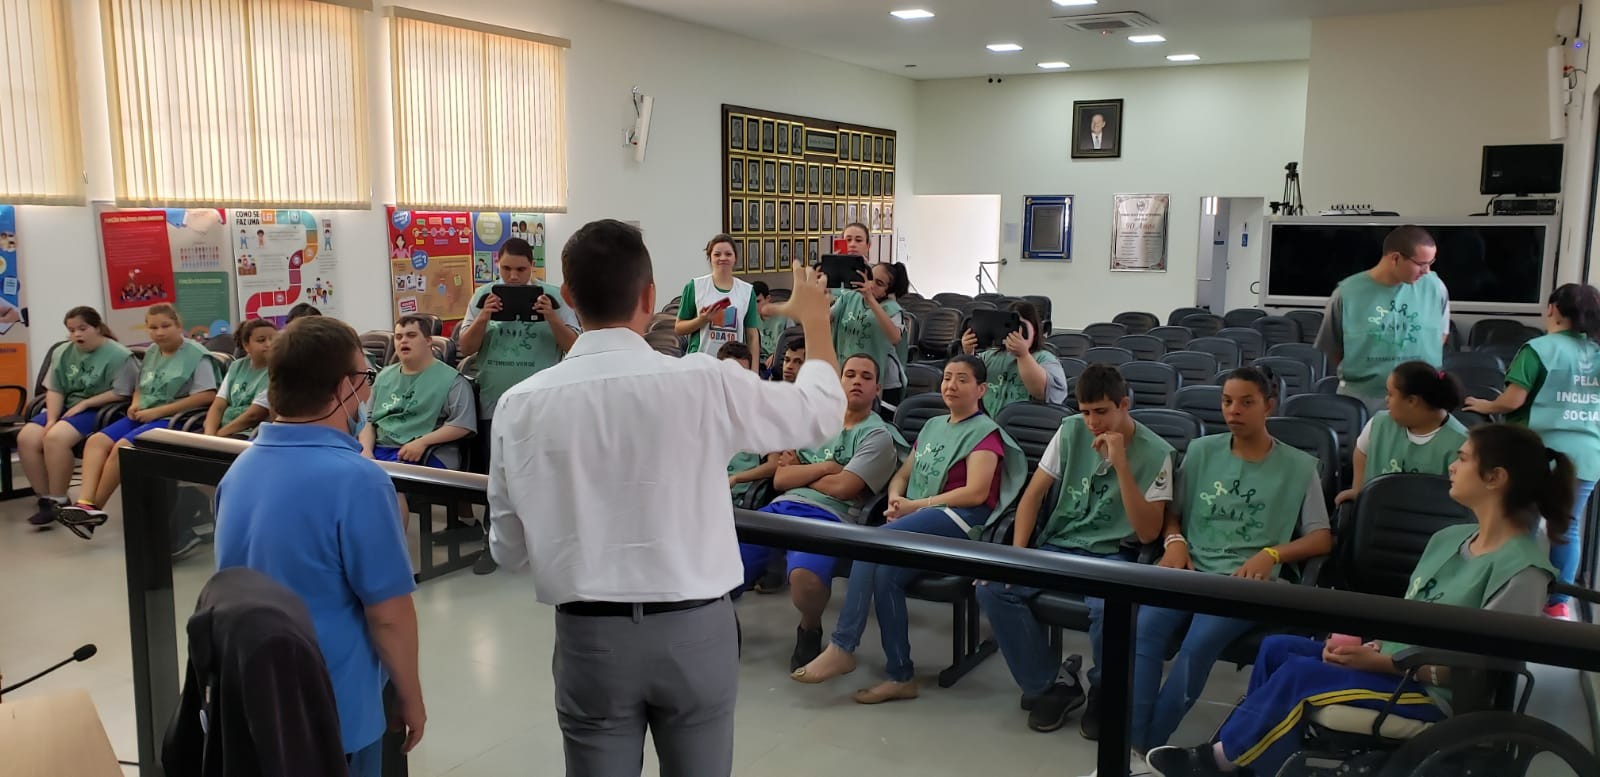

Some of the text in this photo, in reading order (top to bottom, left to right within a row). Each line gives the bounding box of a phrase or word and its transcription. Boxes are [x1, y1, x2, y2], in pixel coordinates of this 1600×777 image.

[235, 210, 252, 218] COMO
[253, 210, 260, 218] SE
[235, 218, 260, 226] FAZ UMA
[1573, 375, 1600, 386] PELA
